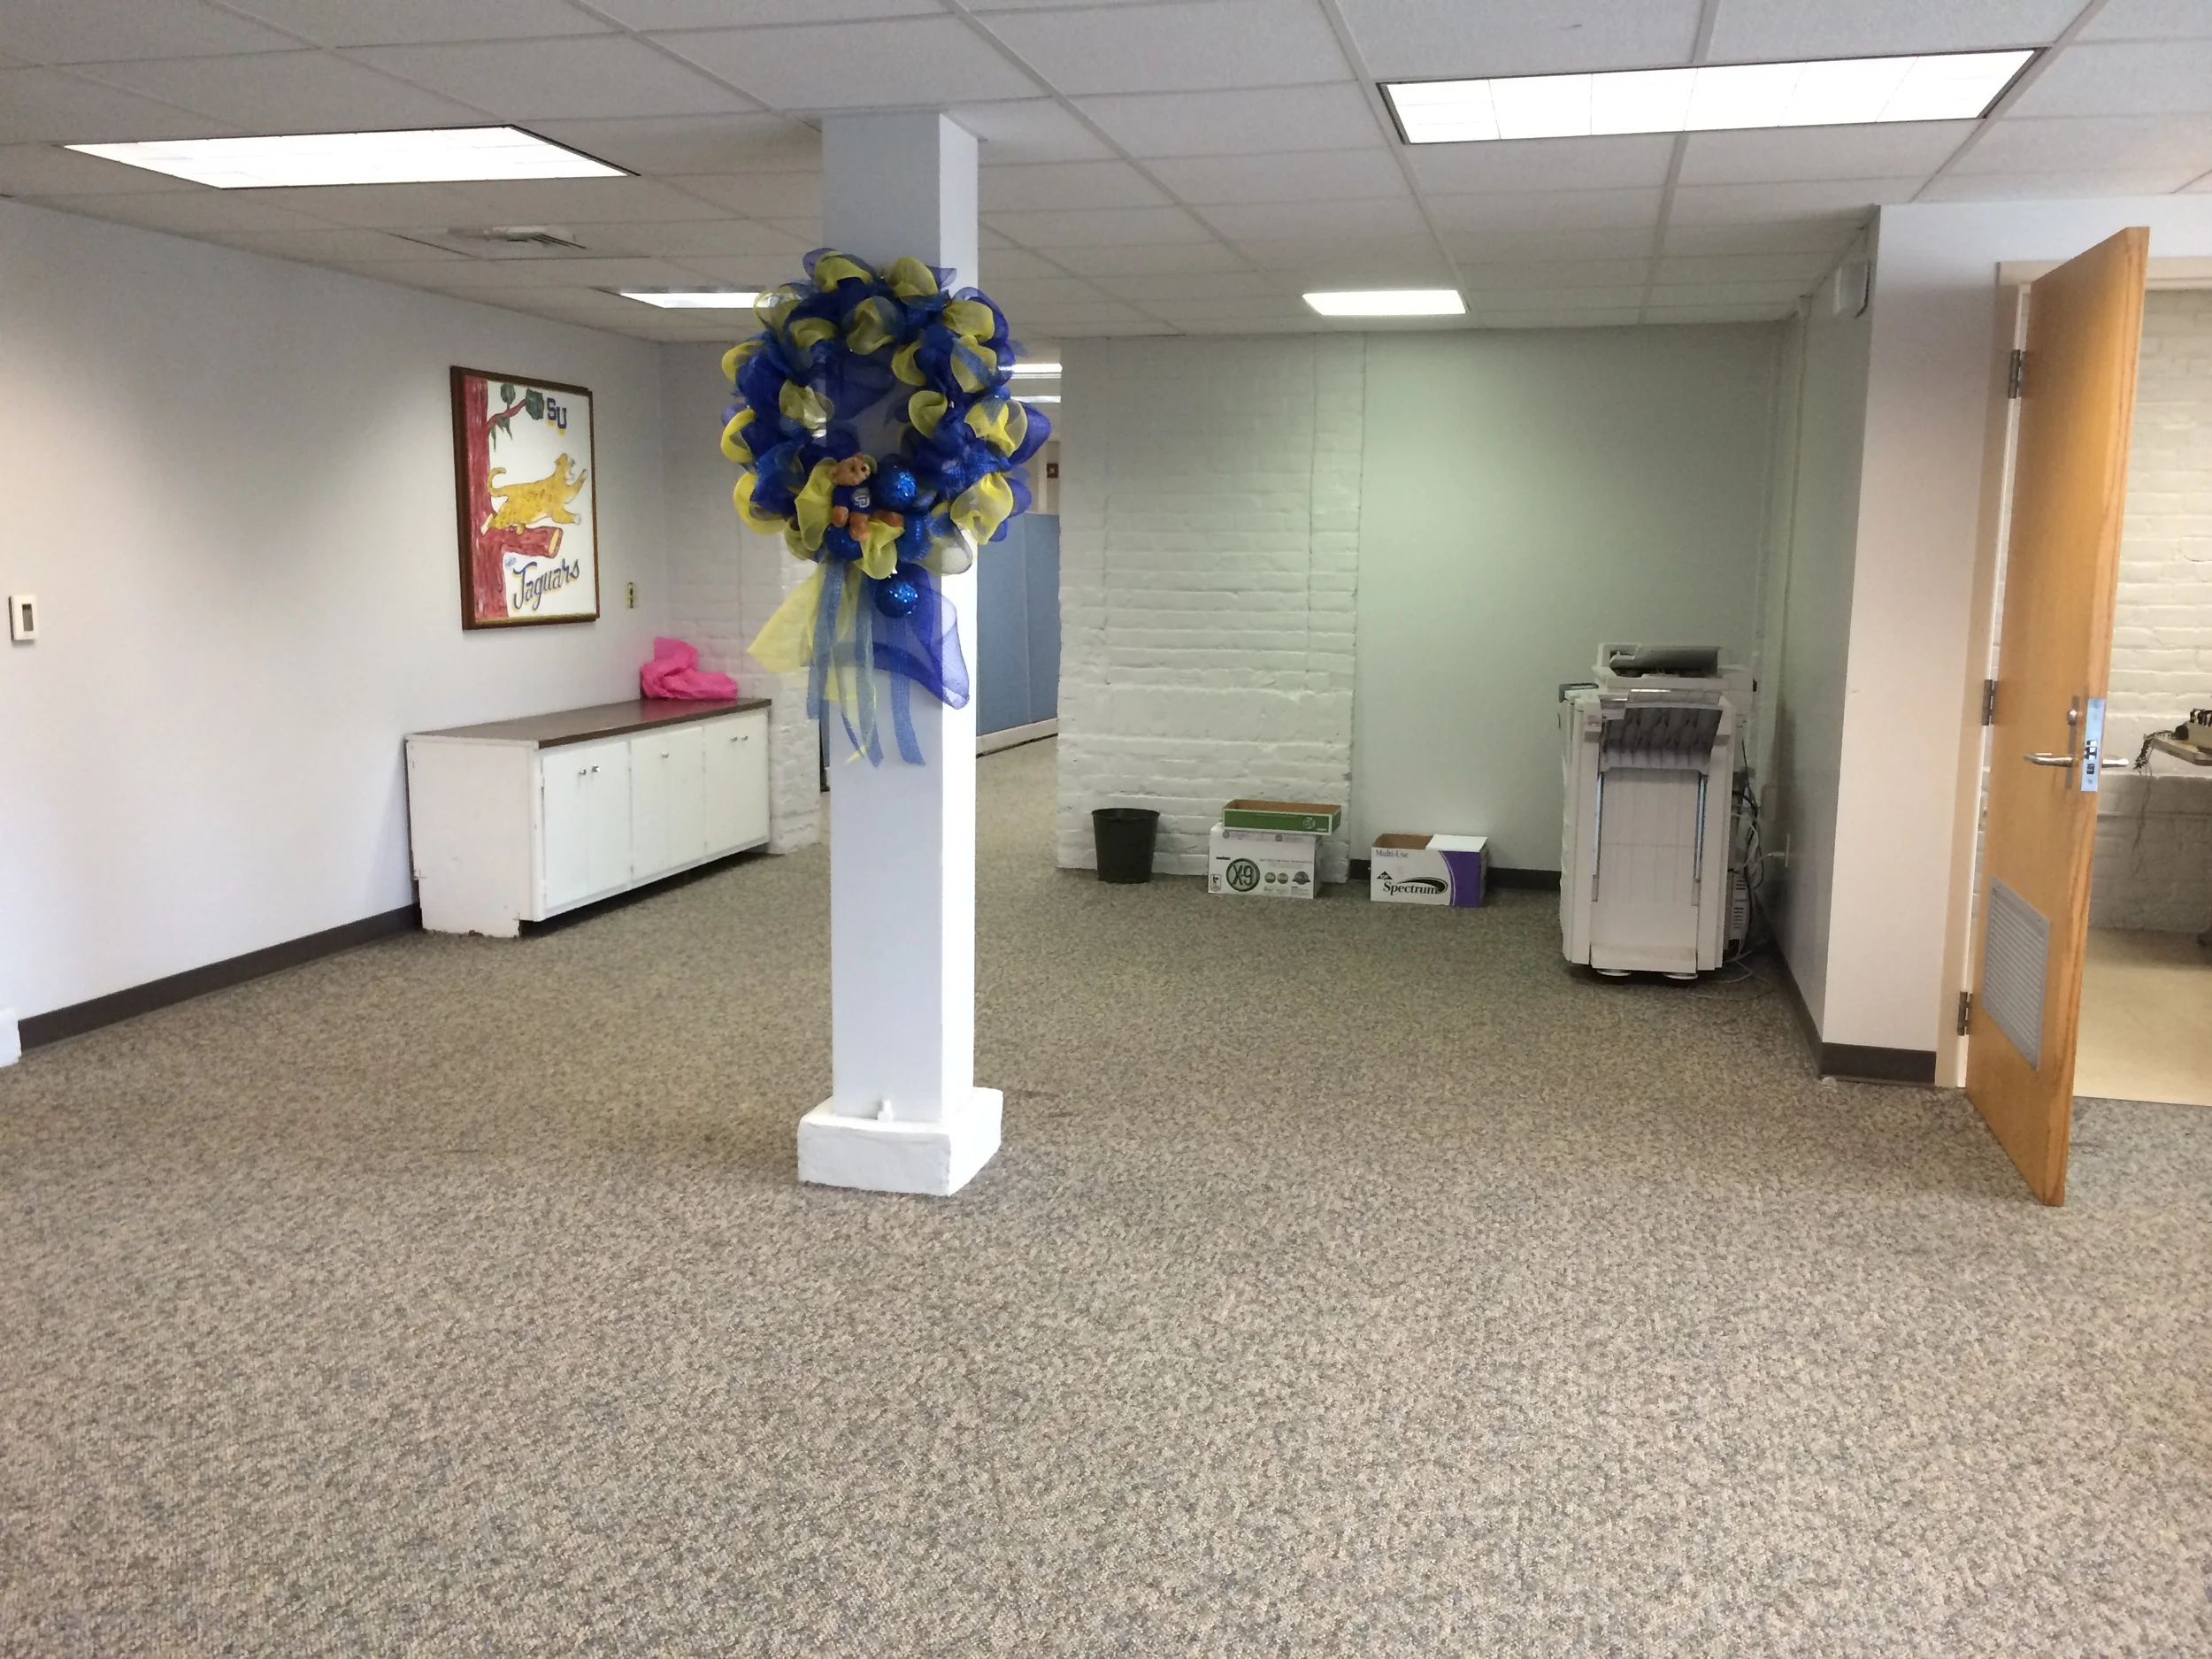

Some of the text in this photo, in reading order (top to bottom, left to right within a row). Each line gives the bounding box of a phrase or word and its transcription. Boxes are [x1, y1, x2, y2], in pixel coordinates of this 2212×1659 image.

[547, 397, 567, 429] SU
[513, 557, 580, 611] Jaguars
[1383, 881, 1438, 895] Spectrum
